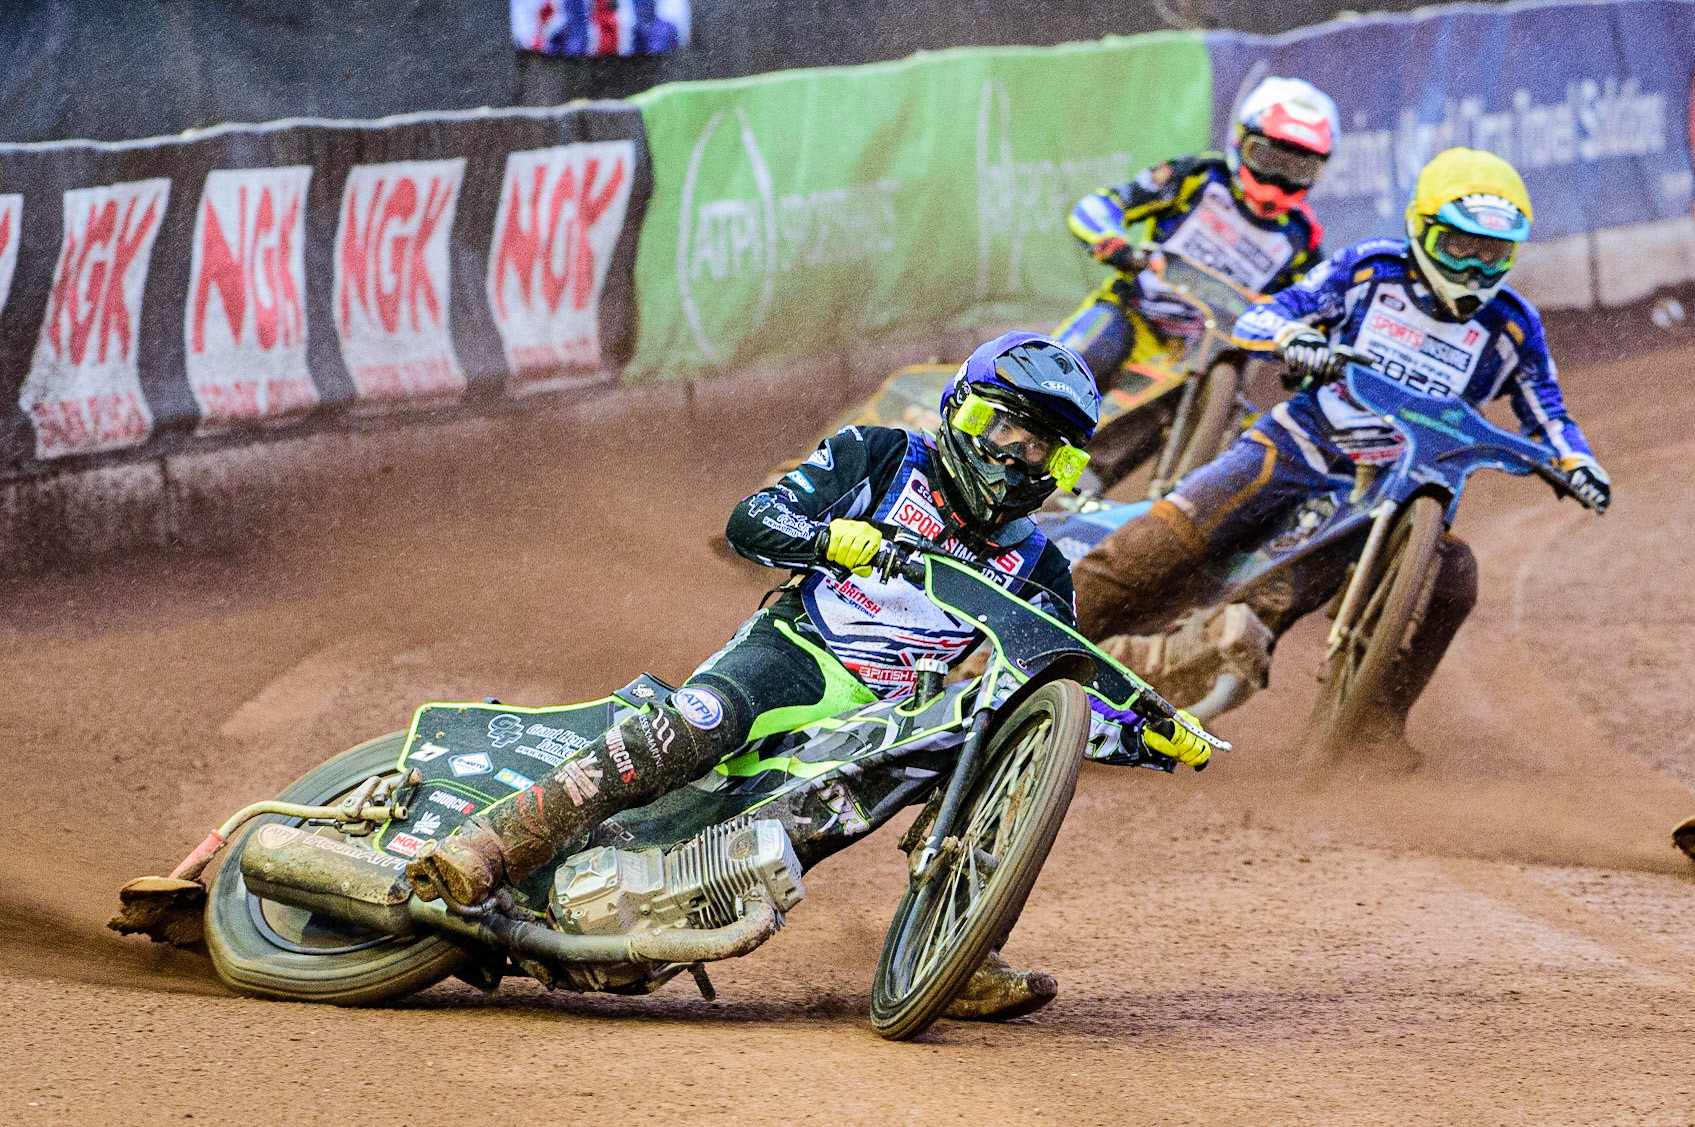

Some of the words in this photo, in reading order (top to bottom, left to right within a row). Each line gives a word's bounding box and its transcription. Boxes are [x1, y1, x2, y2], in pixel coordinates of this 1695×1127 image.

[494, 157, 625, 322] NGK
[192, 186, 304, 353] NGK
[341, 173, 454, 341] NGK
[838, 582, 882, 615] BRITISH
[848, 599, 877, 619] SPEEDWAY
[859, 666, 911, 681] BRITISH
[685, 692, 713, 720] ATPI
[392, 835, 423, 852] NGK
